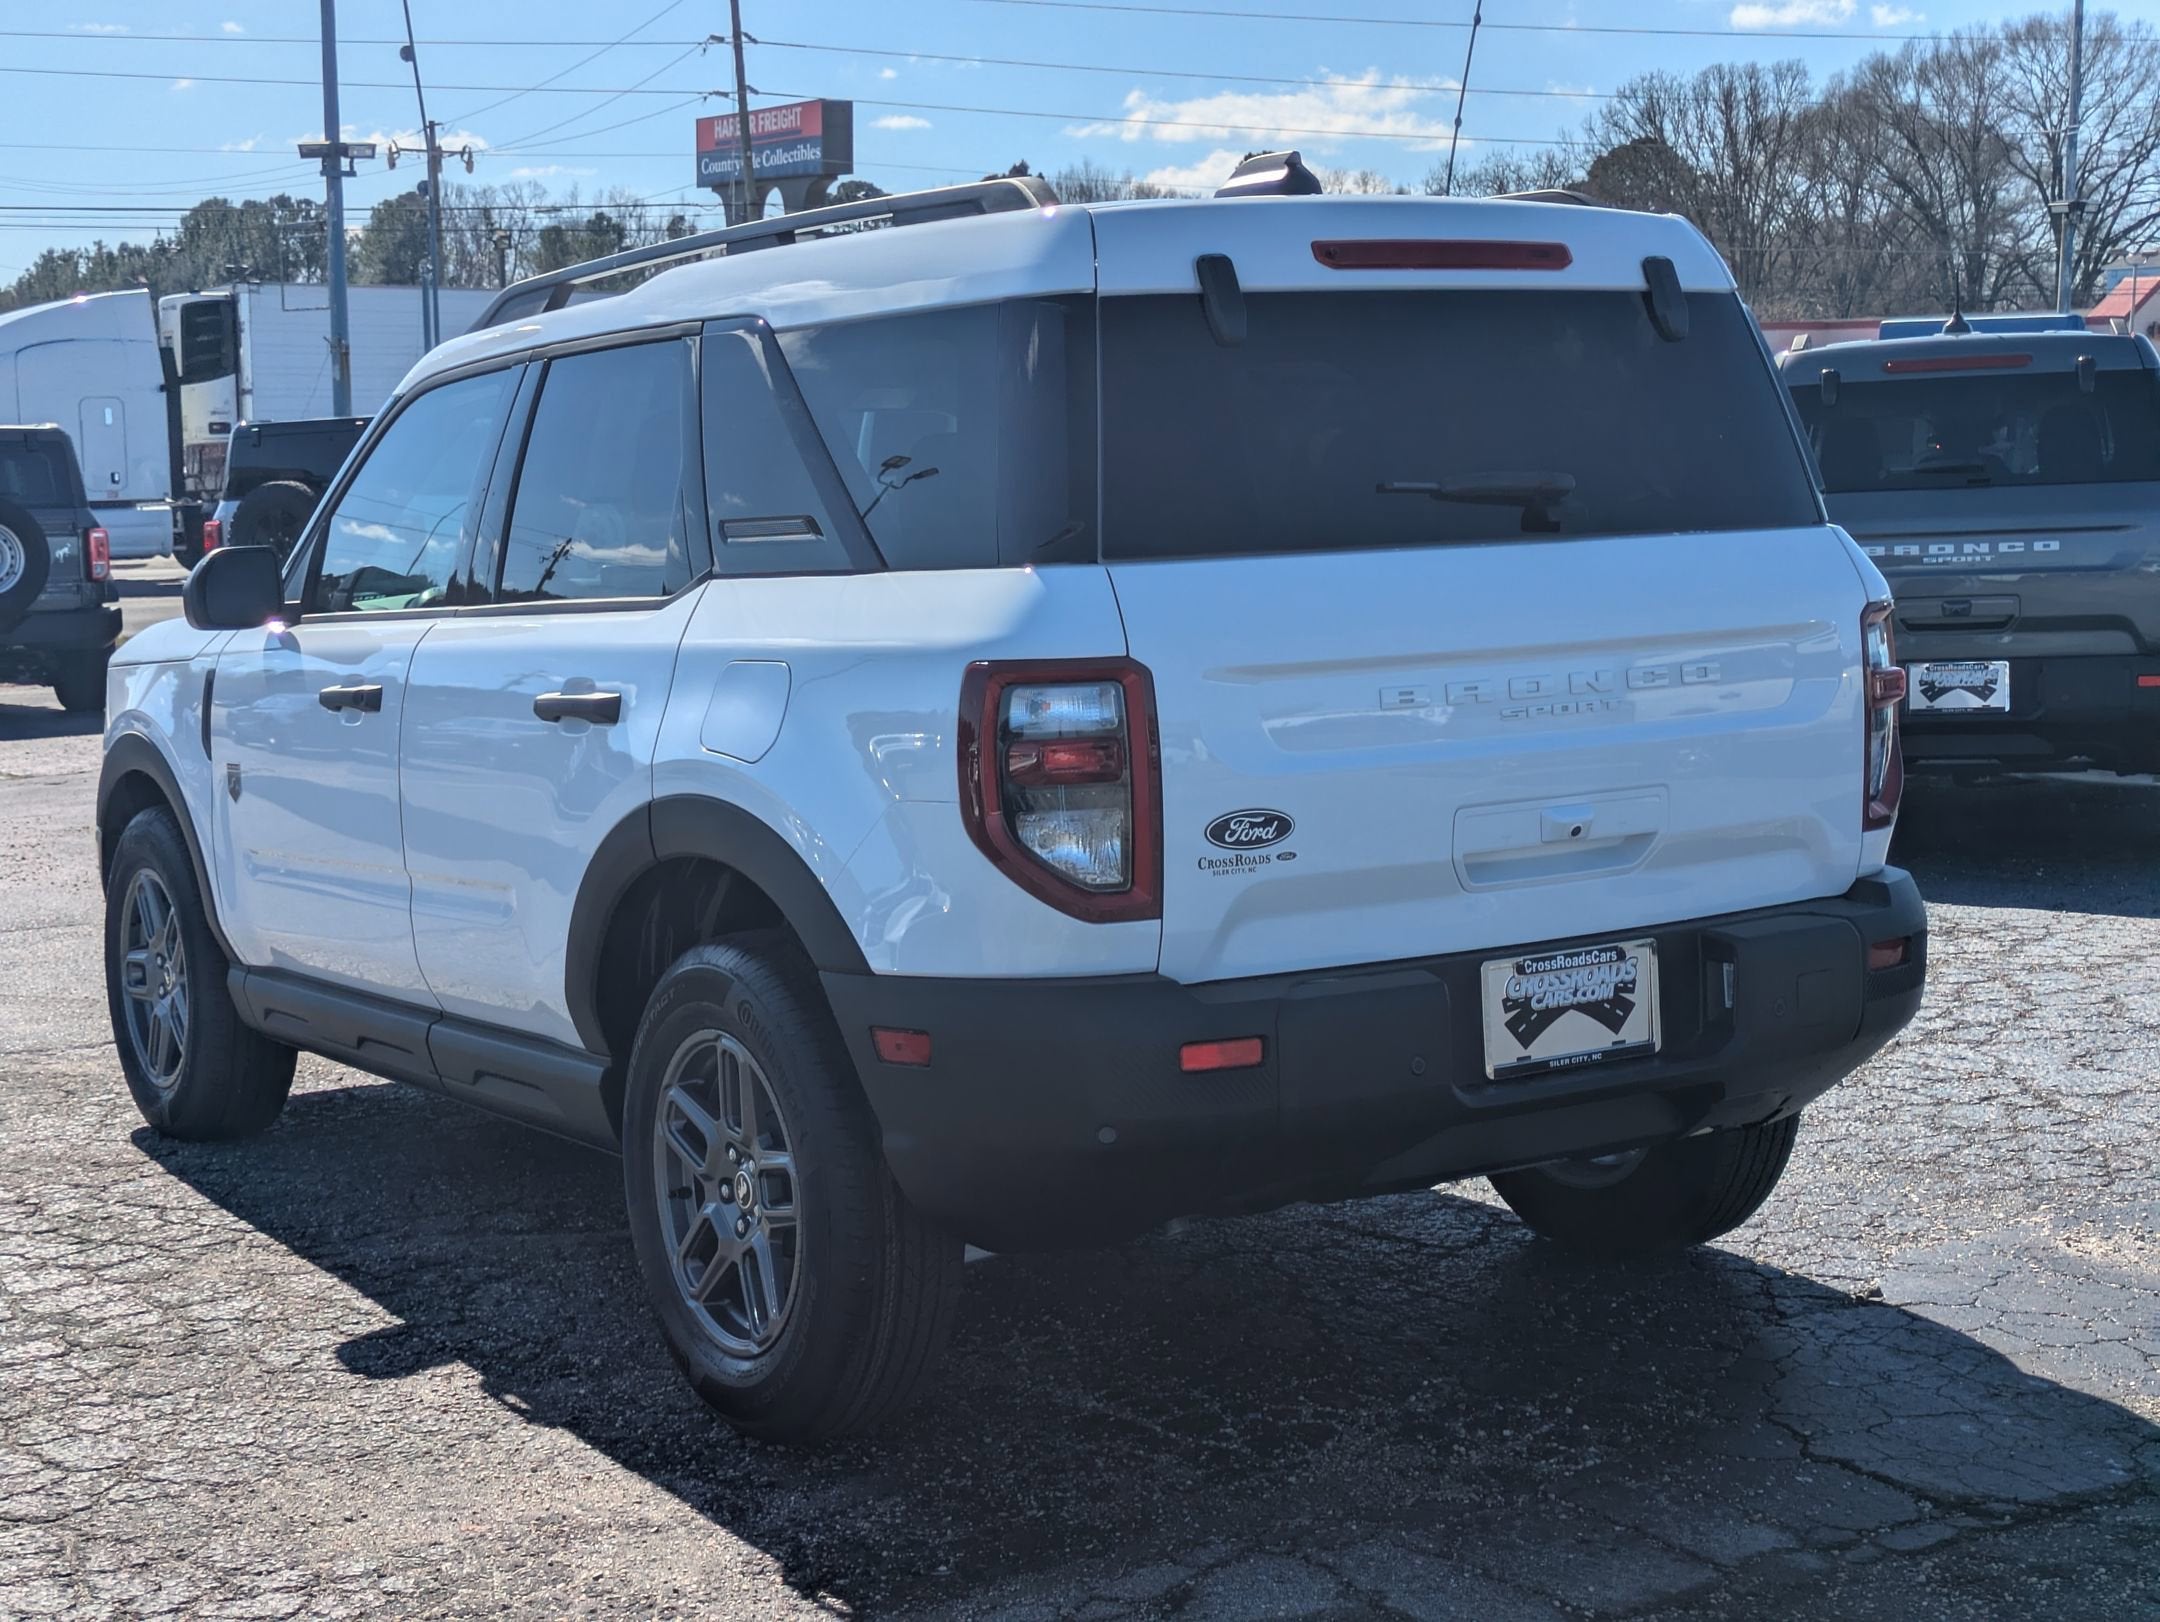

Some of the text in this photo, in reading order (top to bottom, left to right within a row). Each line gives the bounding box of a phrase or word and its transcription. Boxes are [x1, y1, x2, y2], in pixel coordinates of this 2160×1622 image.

[714, 107, 802, 139] HARBR FREIGHT
[762, 143, 822, 168] Collectibles
[1862, 540, 2060, 556] BRONCO
[1923, 555, 1995, 564] SPORT
[1379, 663, 1720, 711] BRONCO
[1501, 700, 1620, 720] SPORT
[1225, 816, 1278, 842] Ford
[1213, 869, 1229, 877] SILER
[1524, 951, 1617, 974] CrossRoadsCars
[1505, 957, 1637, 1000] CROSSROADS
[1531, 982, 1615, 1011] CARS.COM
[1550, 1059, 1570, 1067] SILER
[1571, 1056, 1590, 1064] CITY,
